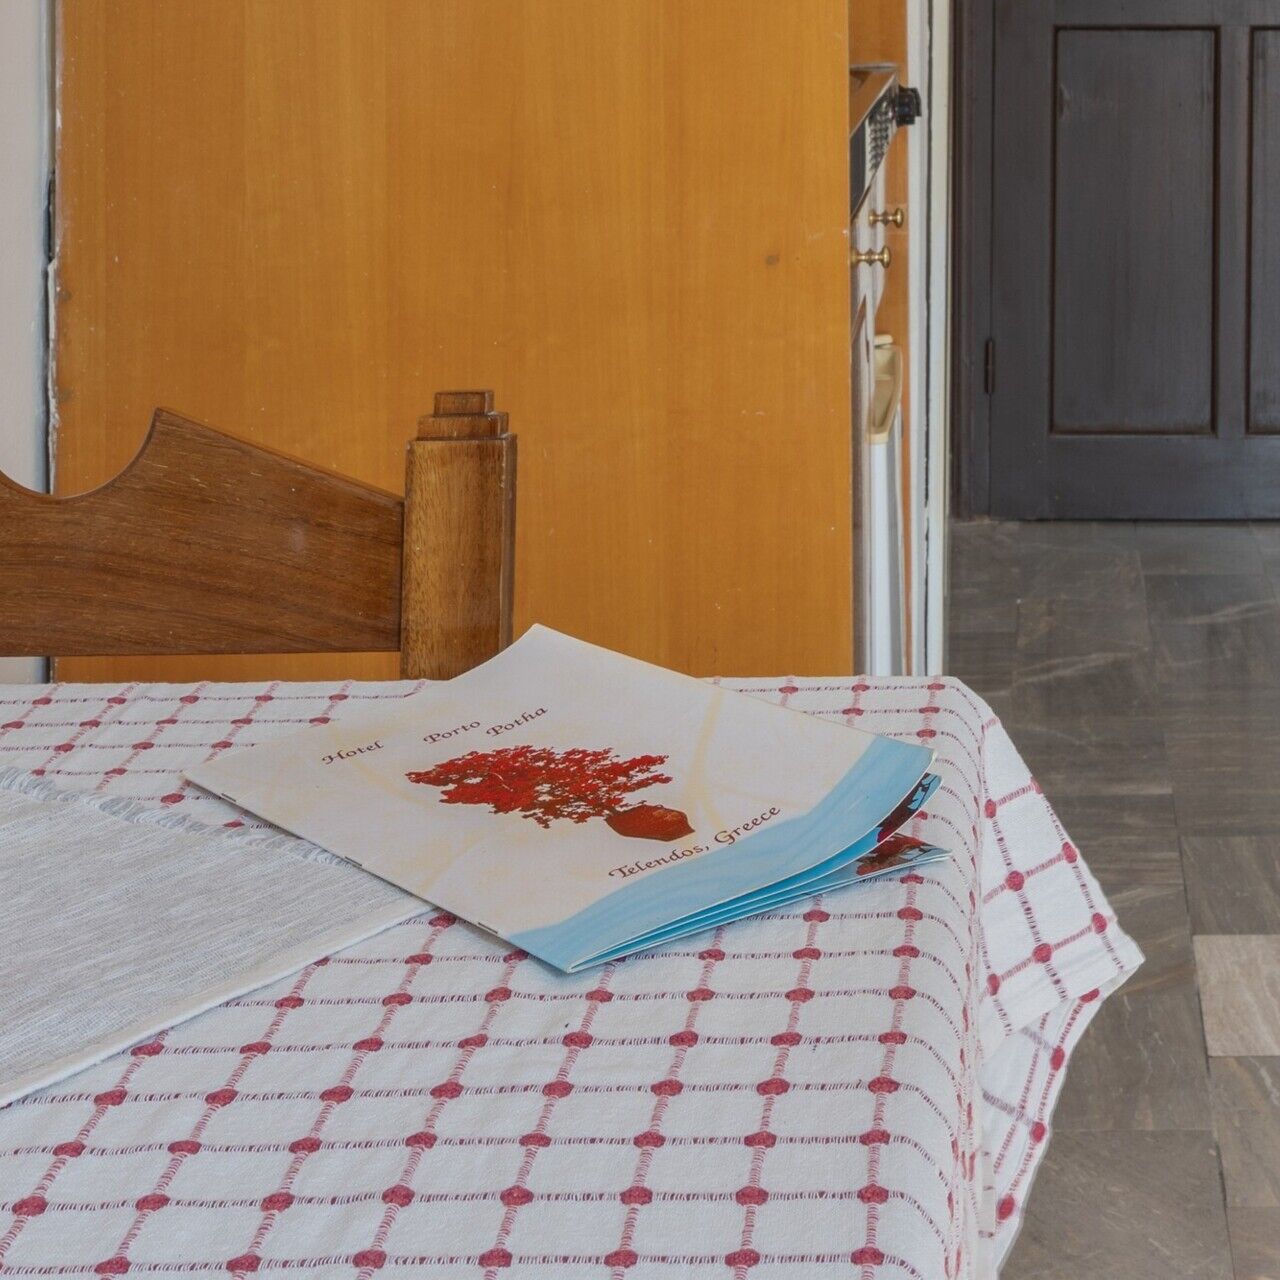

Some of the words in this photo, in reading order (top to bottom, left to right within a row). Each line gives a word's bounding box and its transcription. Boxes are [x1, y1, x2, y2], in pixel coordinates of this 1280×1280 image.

[322, 740, 384, 765] Hotel
[423, 720, 481, 744] Porto
[486, 706, 548, 737] Potha
[608, 845, 709, 879] Telendos,
[714, 807, 781, 845] Greece
